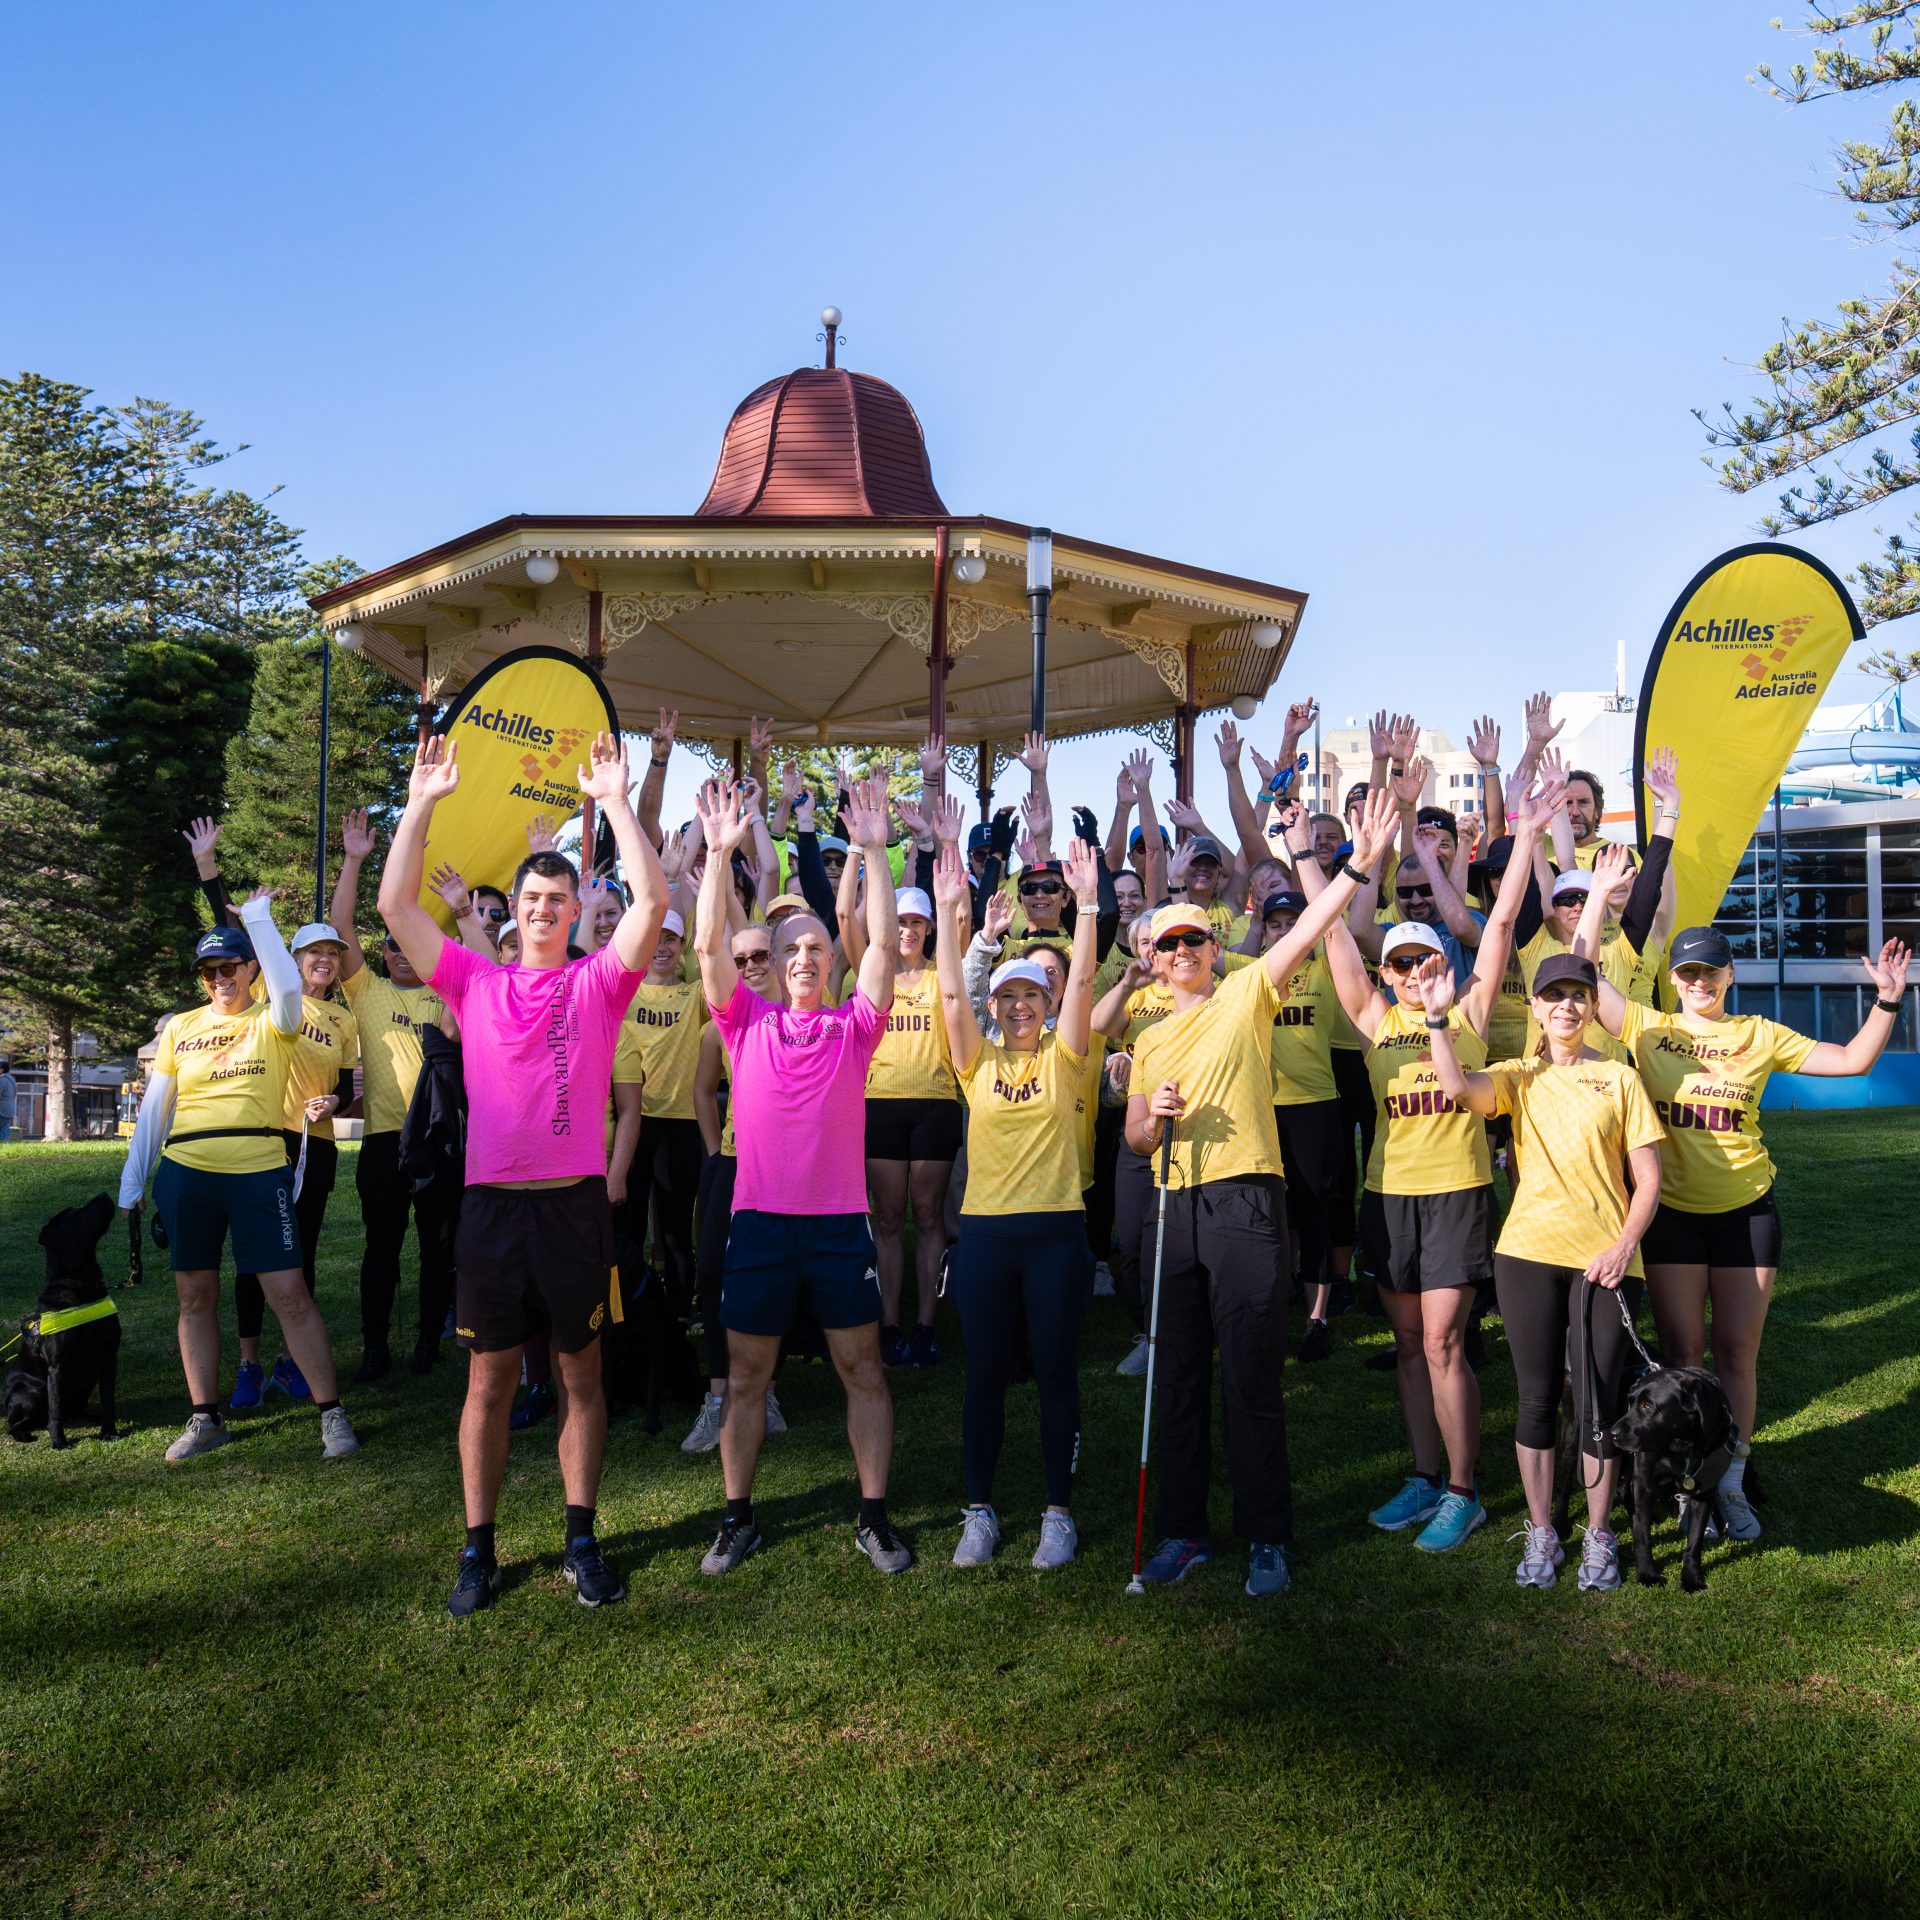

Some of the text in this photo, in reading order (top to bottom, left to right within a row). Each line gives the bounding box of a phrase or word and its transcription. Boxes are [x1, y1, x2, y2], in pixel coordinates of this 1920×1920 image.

[1674, 618, 1775, 643] Achilles
[1771, 670, 1817, 682] Australia
[1734, 680, 1817, 700] Adelaide
[462, 704, 555, 746] Achilles
[496, 734, 551, 753] INTERNATIONAL
[509, 782, 577, 810] Adelaide
[543, 779, 579, 795] Australia
[893, 992, 917, 1001] chilles
[1502, 981, 1527, 994] VISI
[391, 1011, 411, 1028] LOW
[1131, 1006, 1173, 1018] chille
[1274, 1005, 1315, 1026] IDE
[886, 1014, 931, 1032] GUIDE
[1377, 1031, 1431, 1050] Achille
[1655, 1035, 1730, 1059] Achilles
[234, 1058, 266, 1067] Australia
[210, 1065, 266, 1081] Adelaide
[1690, 1085, 1755, 1103] Adelaide
[1722, 1080, 1756, 1092] Australia
[1655, 1100, 1748, 1133] GUIDE
[282, 1223, 295, 1251] Klein
